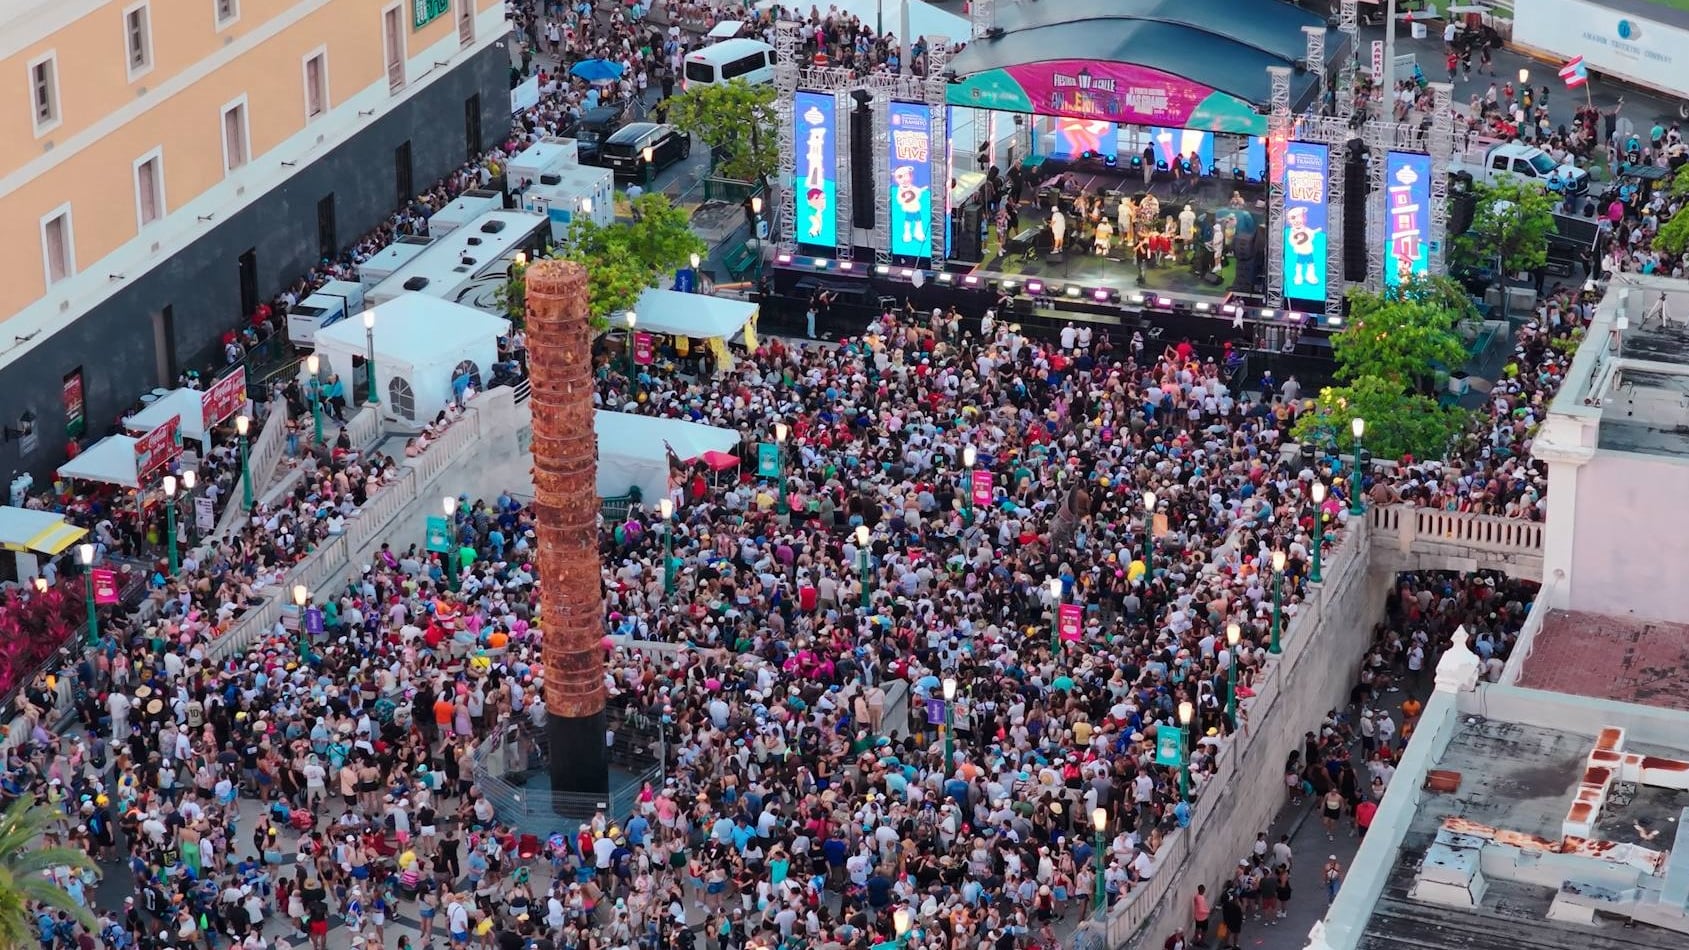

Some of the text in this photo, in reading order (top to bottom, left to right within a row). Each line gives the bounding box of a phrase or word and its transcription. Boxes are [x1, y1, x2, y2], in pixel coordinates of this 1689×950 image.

[1373, 41, 1382, 79] PARKIN
[1098, 79, 1116, 92] CALLE
[190, 709, 199, 718] 10
[710, 848, 718, 859] 7
